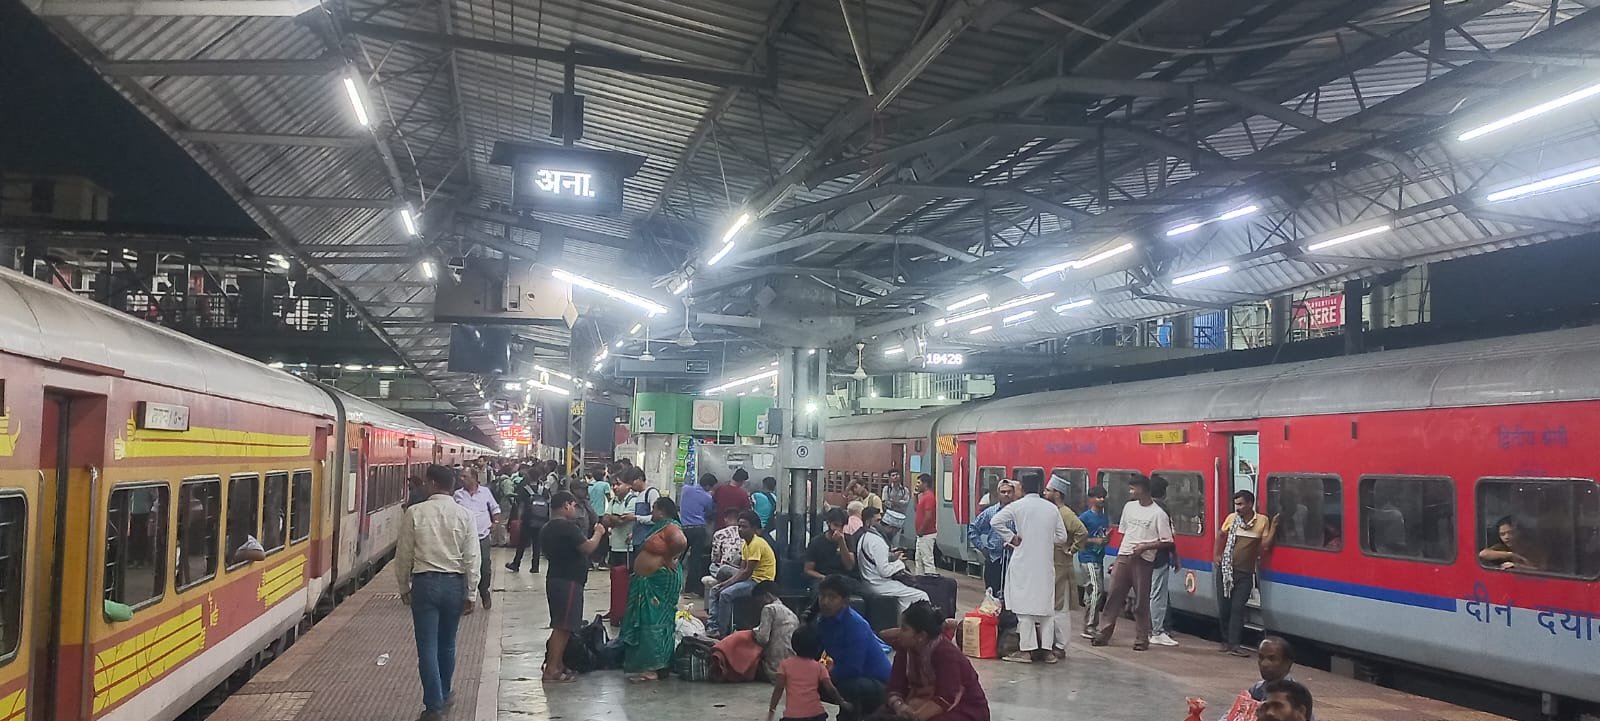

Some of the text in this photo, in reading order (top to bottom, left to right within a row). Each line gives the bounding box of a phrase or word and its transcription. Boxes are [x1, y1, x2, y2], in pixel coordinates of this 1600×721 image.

[534, 168, 596, 197] अना.
[1465, 579, 1600, 641] दीन दया
